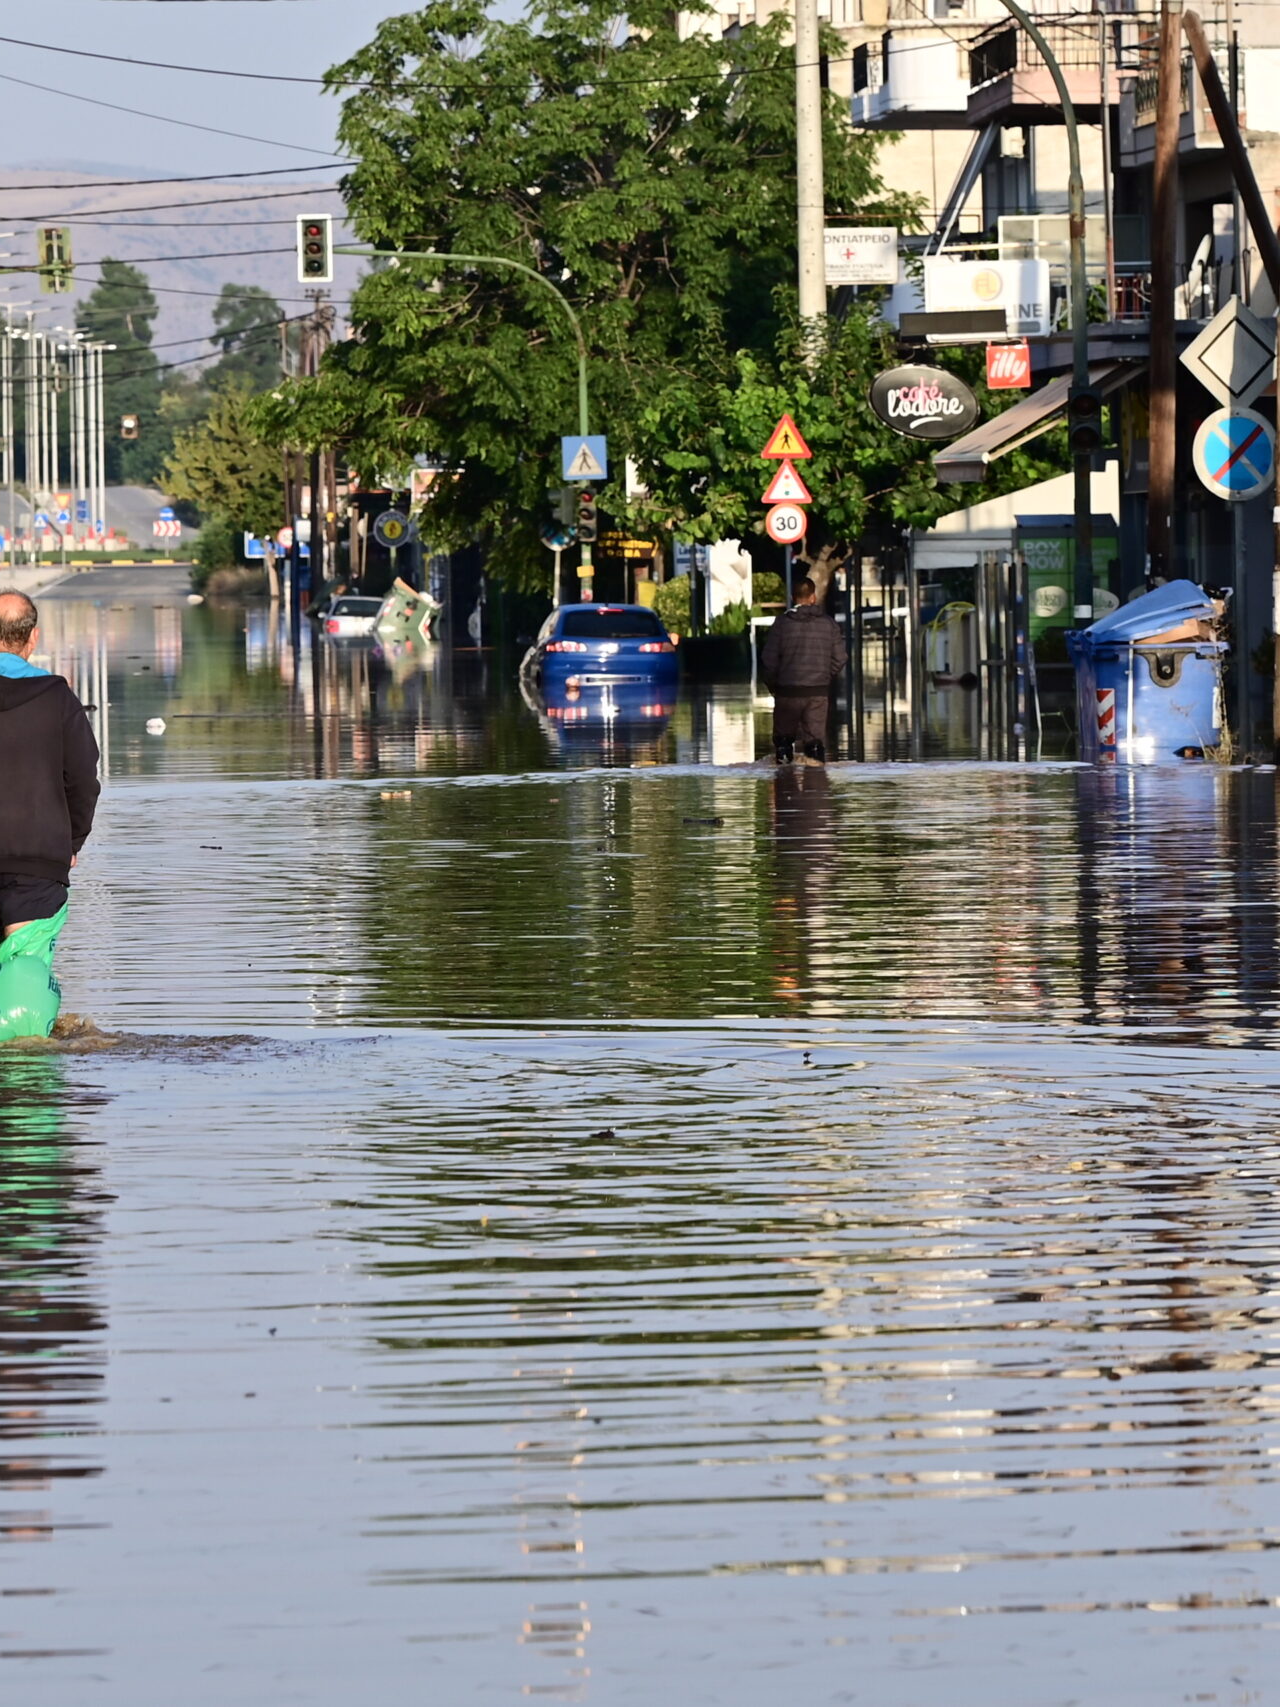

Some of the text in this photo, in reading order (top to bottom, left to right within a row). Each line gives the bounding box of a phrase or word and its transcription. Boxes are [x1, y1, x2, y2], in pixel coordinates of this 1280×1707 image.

[990, 351, 1027, 381] illy
[898, 376, 942, 402] café
[776, 516, 797, 531] 30
[1023, 541, 1061, 555] BOX
[1024, 555, 1064, 569] NOW
